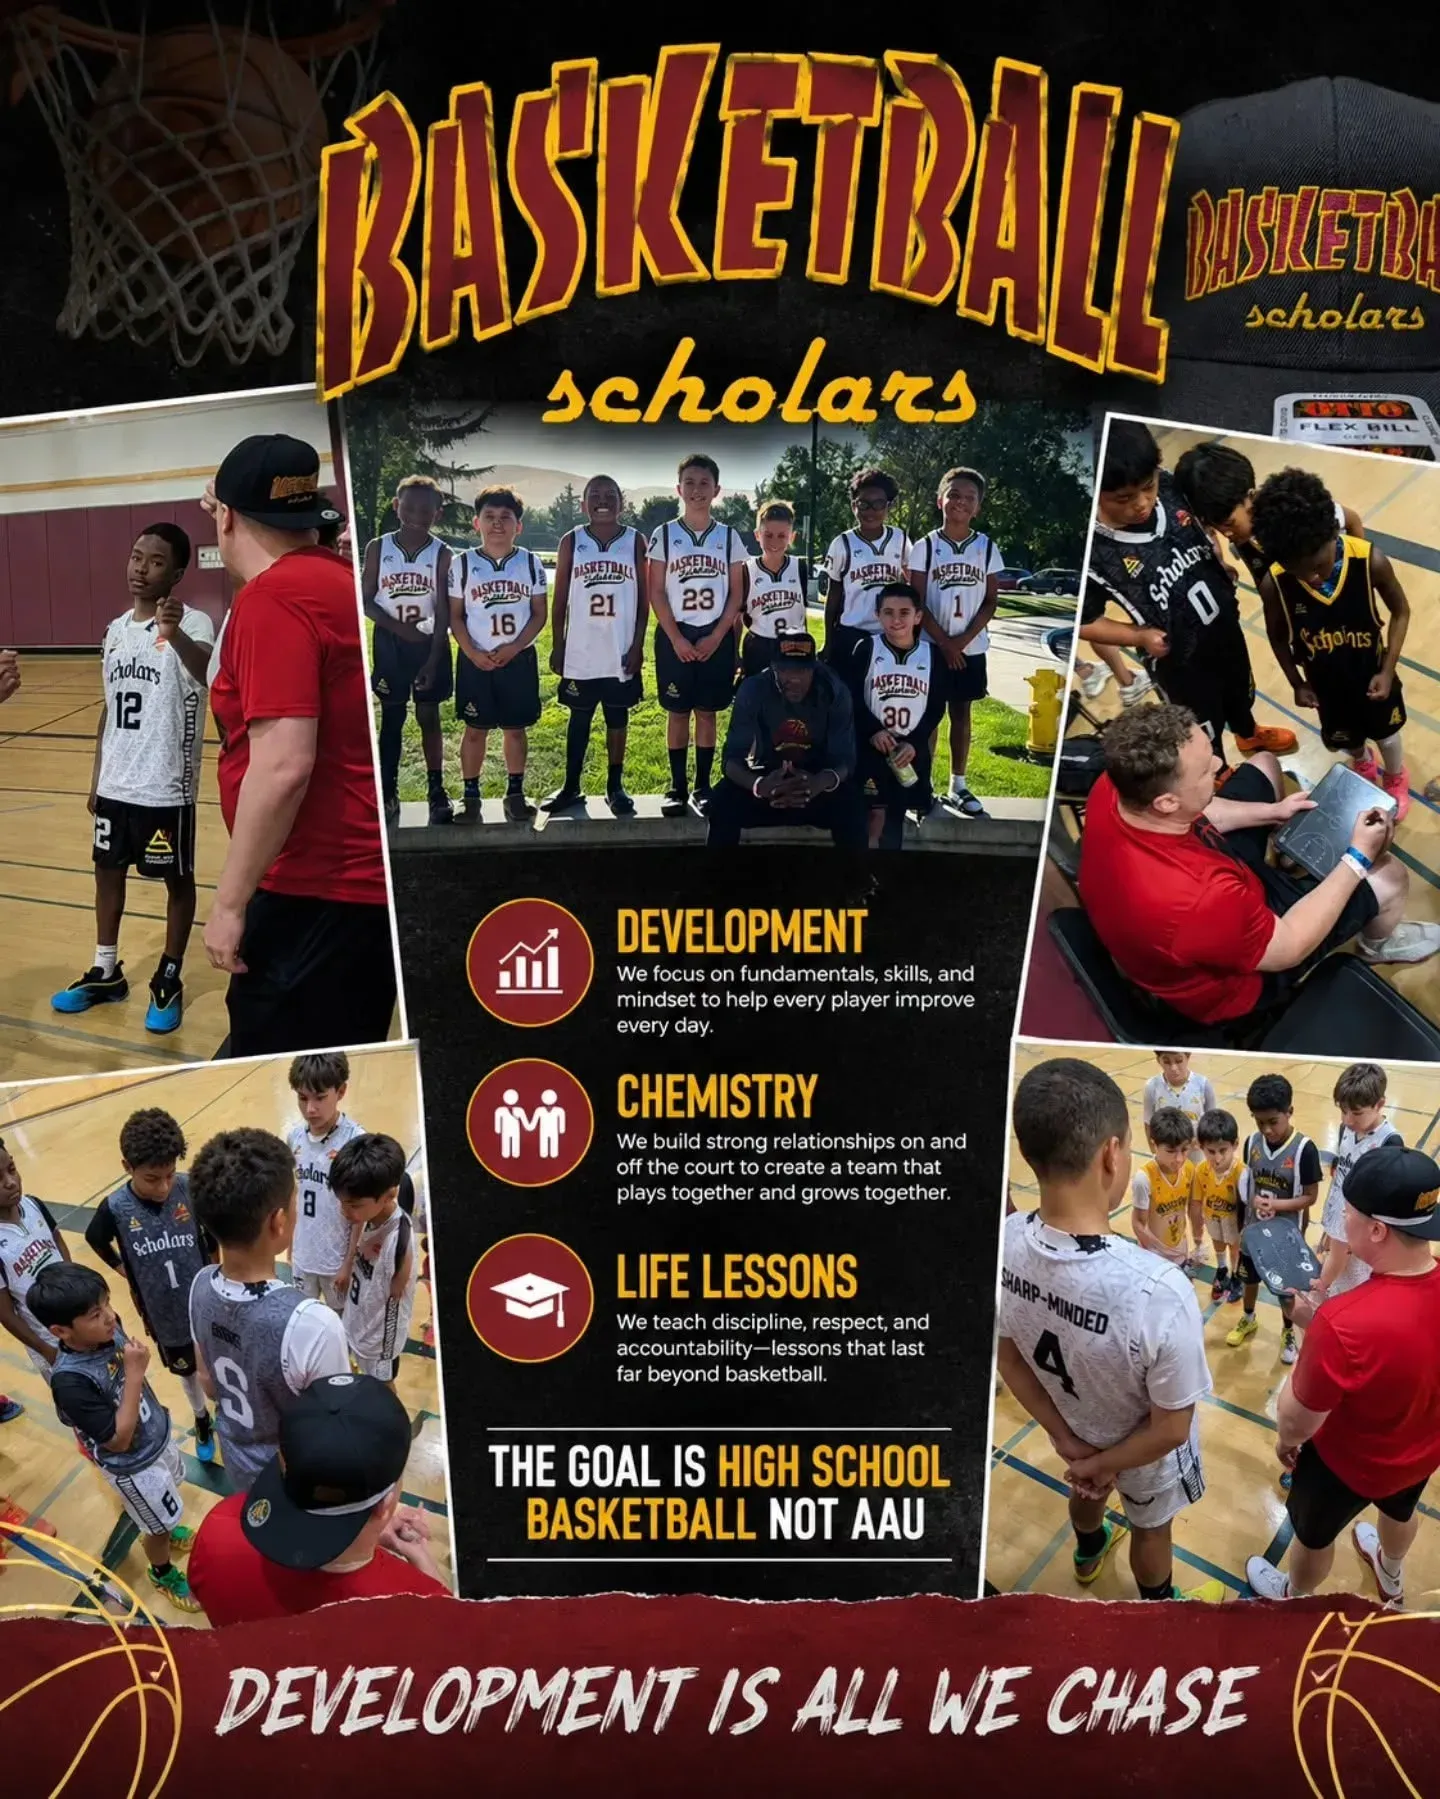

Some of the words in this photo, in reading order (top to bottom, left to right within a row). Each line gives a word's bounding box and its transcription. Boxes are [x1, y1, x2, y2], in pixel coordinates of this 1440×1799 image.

[316, 43, 1180, 401] BASKETBALL
[1244, 292, 1425, 330] scholars
[541, 336, 977, 424] scholars
[1300, 422, 1358, 432] FLEX
[1366, 423, 1420, 433] BILL
[589, 593, 617, 617] 21
[682, 588, 715, 611] 23
[953, 594, 963, 618] 1
[1187, 580, 1220, 625] 0
[490, 613, 517, 637] 16
[115, 691, 142, 730] 12
[882, 706, 911, 730] 30
[618, 908, 868, 953] DEVELOPMENT
[617, 966, 647, 982] We
[653, 965, 705, 982] focus
[711, 969, 734, 982] on
[741, 965, 878, 985] fundamentals,
[884, 965, 932, 985] skills,
[938, 965, 974, 982] and
[618, 991, 696, 1008] mindset
[701, 993, 720, 1008] to
[727, 991, 768, 1012] help
[774, 995, 825, 1012] every
[832, 991, 890, 1012] player
[896, 991, 975, 1012] improve
[617, 1021, 669, 1038] every
[675, 1017, 713, 1038] day.
[618, 1074, 818, 1118] CHEMISTRY
[617, 1134, 647, 1150] We
[654, 1133, 700, 1150] build
[707, 1135, 767, 1154] strong
[774, 1133, 895, 1154] relationships
[901, 1137, 924, 1150] on
[930, 1133, 966, 1150] and
[617, 1158, 643, 1176] off
[647, 1158, 679, 1176] the
[685, 1160, 734, 1176] court
[740, 1160, 759, 1176] to
[765, 1160, 825, 1176] create
[831, 1163, 841, 1176] a
[847, 1160, 897, 1176] team
[903, 1158, 941, 1176] that
[618, 1184, 666, 1205] plays
[672, 1184, 754, 1205] together
[760, 1184, 795, 1201] and
[802, 1188, 859, 1205] grows
[865, 1184, 950, 1205] together.
[133, 1230, 195, 1257] Scholars
[164, 1260, 181, 1289] 1
[618, 1254, 689, 1298] LIFE
[703, 1254, 857, 1299] LESSONS
[1001, 1266, 1110, 1335] SHARP-MINDED
[617, 1314, 647, 1330] We
[653, 1314, 706, 1330] teach
[712, 1313, 806, 1334] discipline,
[813, 1315, 887, 1334] respect,
[893, 1313, 929, 1330] and
[617, 1339, 841, 1360] accountability—lessons
[847, 1339, 886, 1356] that
[892, 1340, 925, 1356] last
[617, 1365, 642, 1382] far
[648, 1365, 719, 1386] beyond
[726, 1365, 826, 1382] basketball.
[1033, 1328, 1080, 1400] 4
[488, 1445, 556, 1487] THE
[569, 1445, 660, 1487] GOAL
[675, 1445, 705, 1487] IS
[719, 1445, 799, 1487] HIGH
[812, 1445, 950, 1487] SCHOOL
[527, 1497, 756, 1540] BASKETBALL
[770, 1497, 838, 1540] NOT
[851, 1498, 924, 1540] AAU
[215, 1666, 699, 1736] DEVELOPMENT
[709, 1667, 780, 1735] IS
[792, 1667, 902, 1735] ALL
[929, 1666, 1032, 1735] WE
[1047, 1666, 1259, 1736] CHASE
